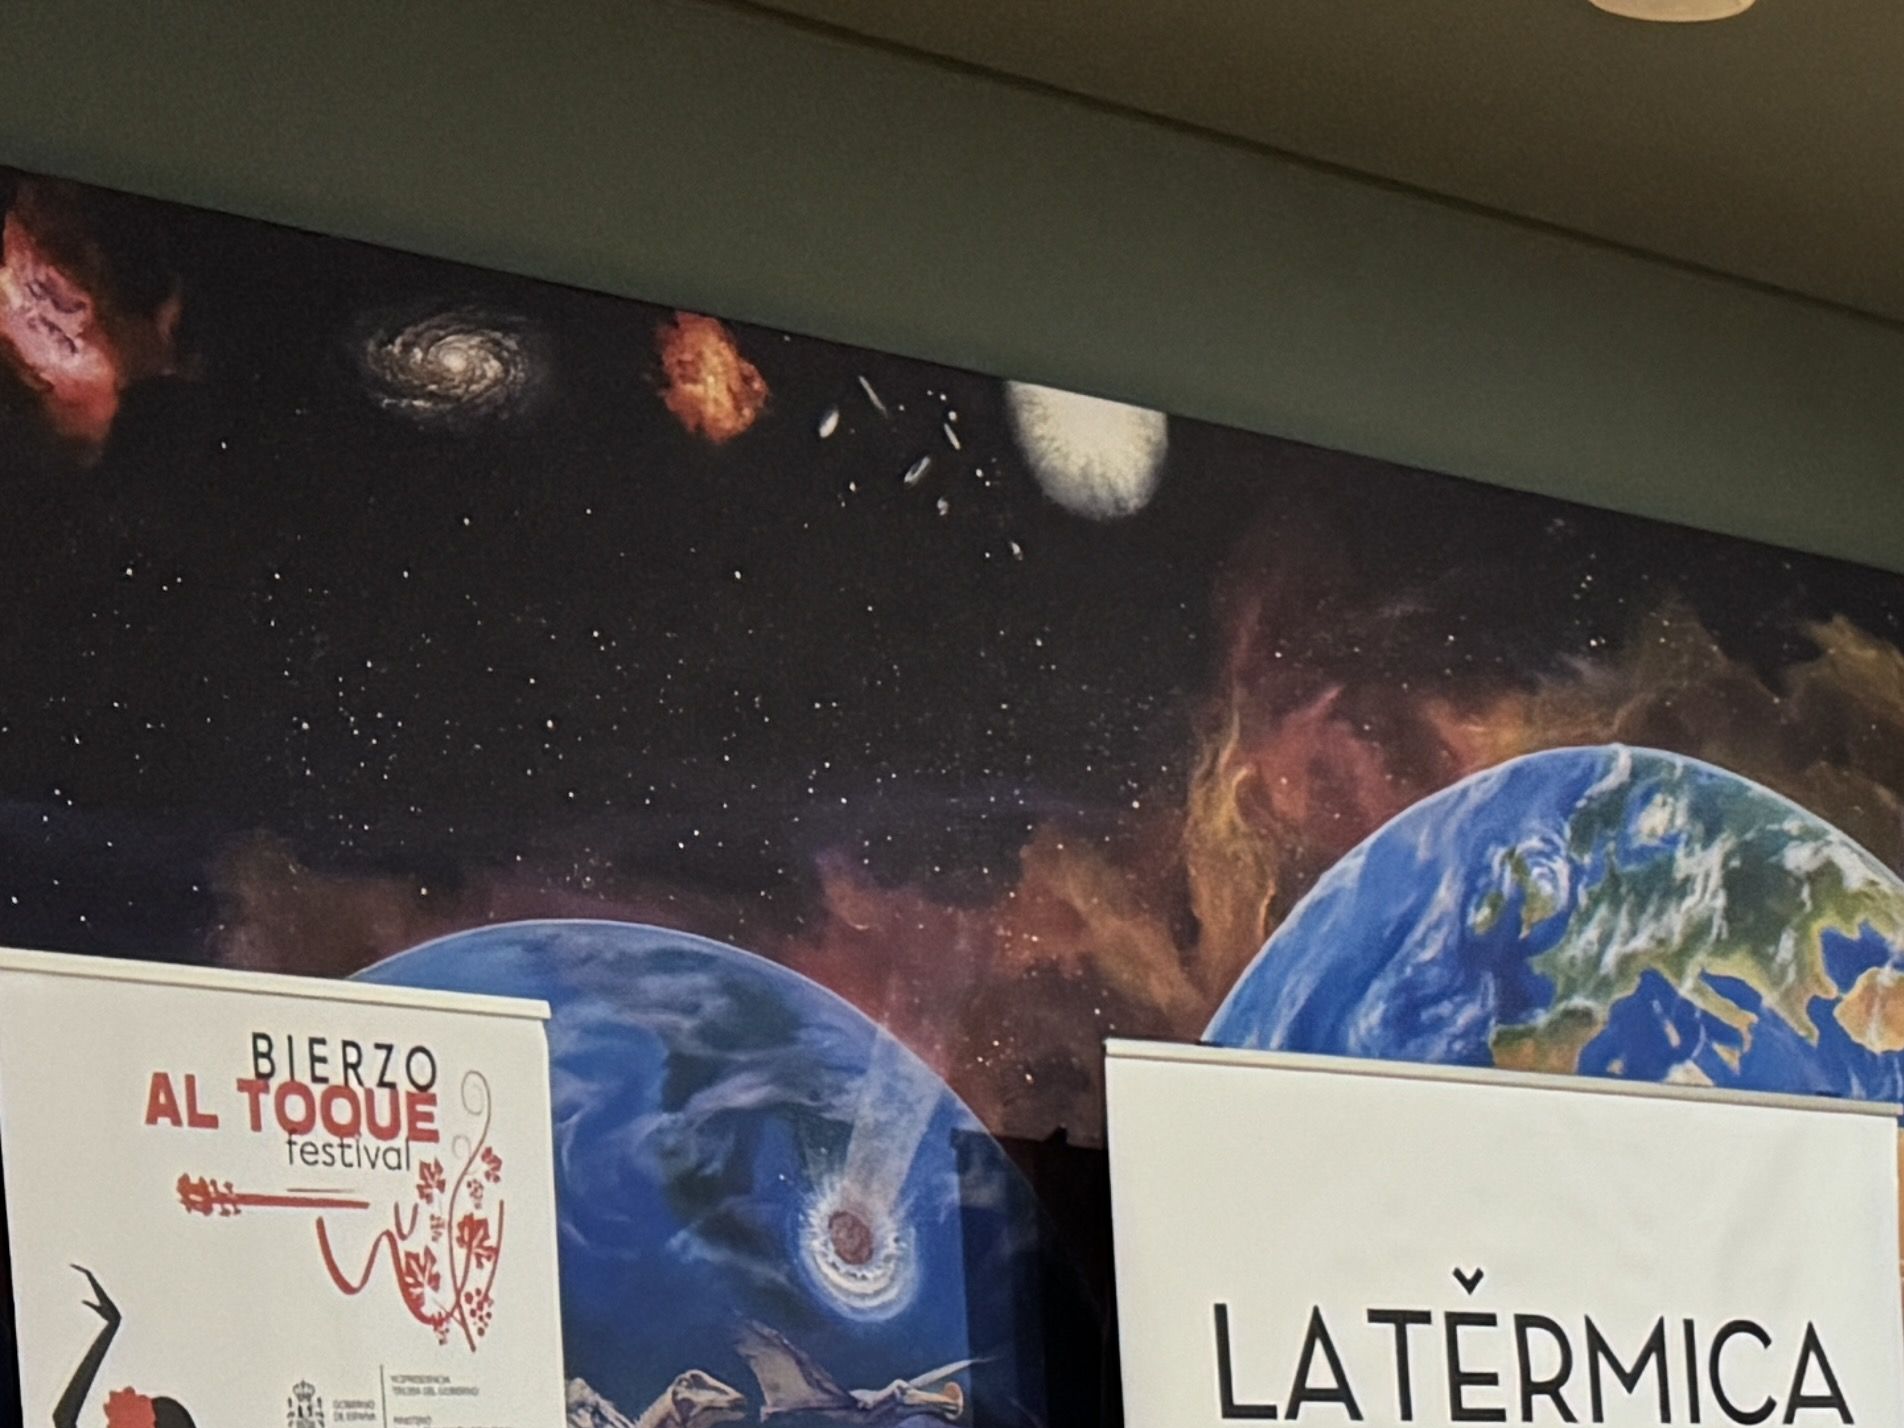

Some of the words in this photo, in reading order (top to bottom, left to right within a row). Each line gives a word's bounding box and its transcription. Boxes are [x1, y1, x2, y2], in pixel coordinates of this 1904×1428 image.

[251, 1031, 437, 1092] BIERZO
[145, 1071, 219, 1130] AL
[236, 1077, 440, 1144] TOQUE
[286, 1127, 411, 1172] festival
